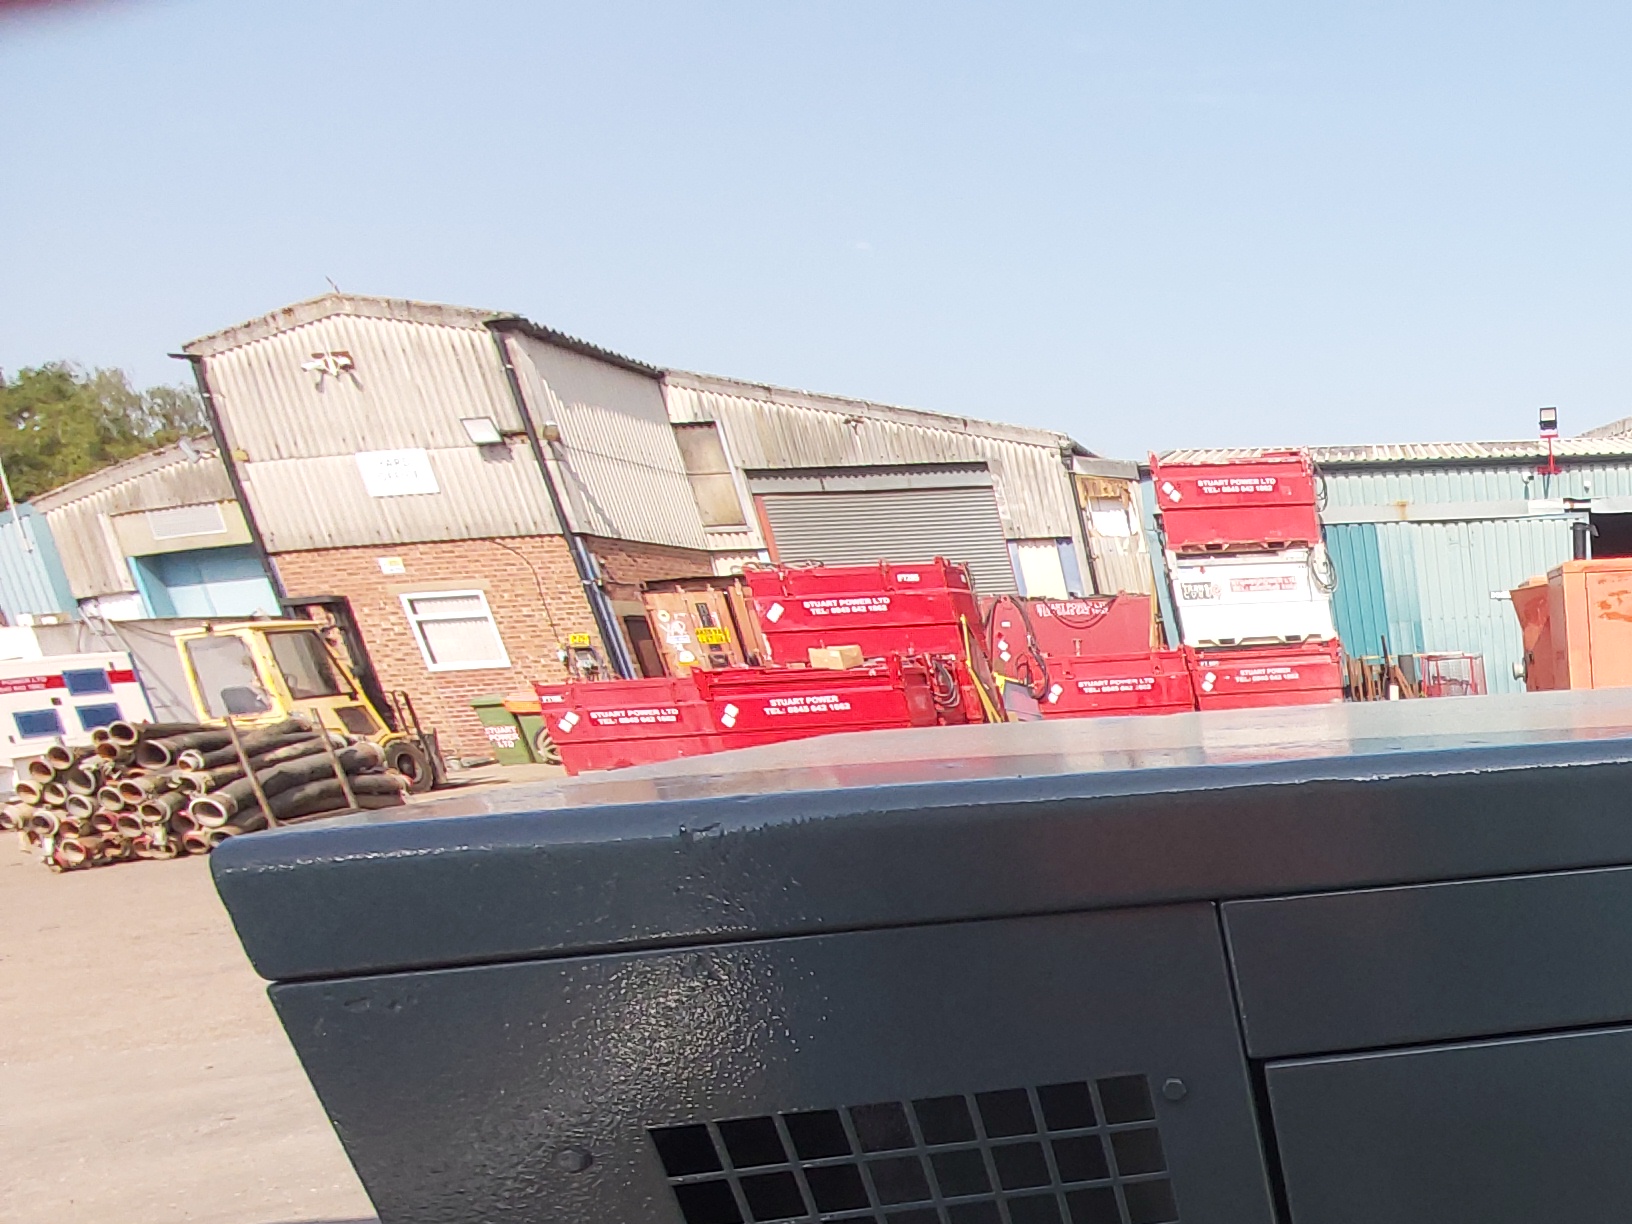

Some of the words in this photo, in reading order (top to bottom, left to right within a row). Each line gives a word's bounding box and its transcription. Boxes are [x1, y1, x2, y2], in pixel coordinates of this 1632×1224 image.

[1260, 477, 1277, 485] LTD
[803, 598, 838, 609] STUART
[838, 597, 873, 607] POWER
[873, 596, 891, 605] LTD
[769, 697, 805, 707] STUART
[805, 695, 840, 704] POWER
[589, 710, 626, 719] STUART
[626, 709, 661, 718] POWER
[660, 708, 679, 716] LTD
